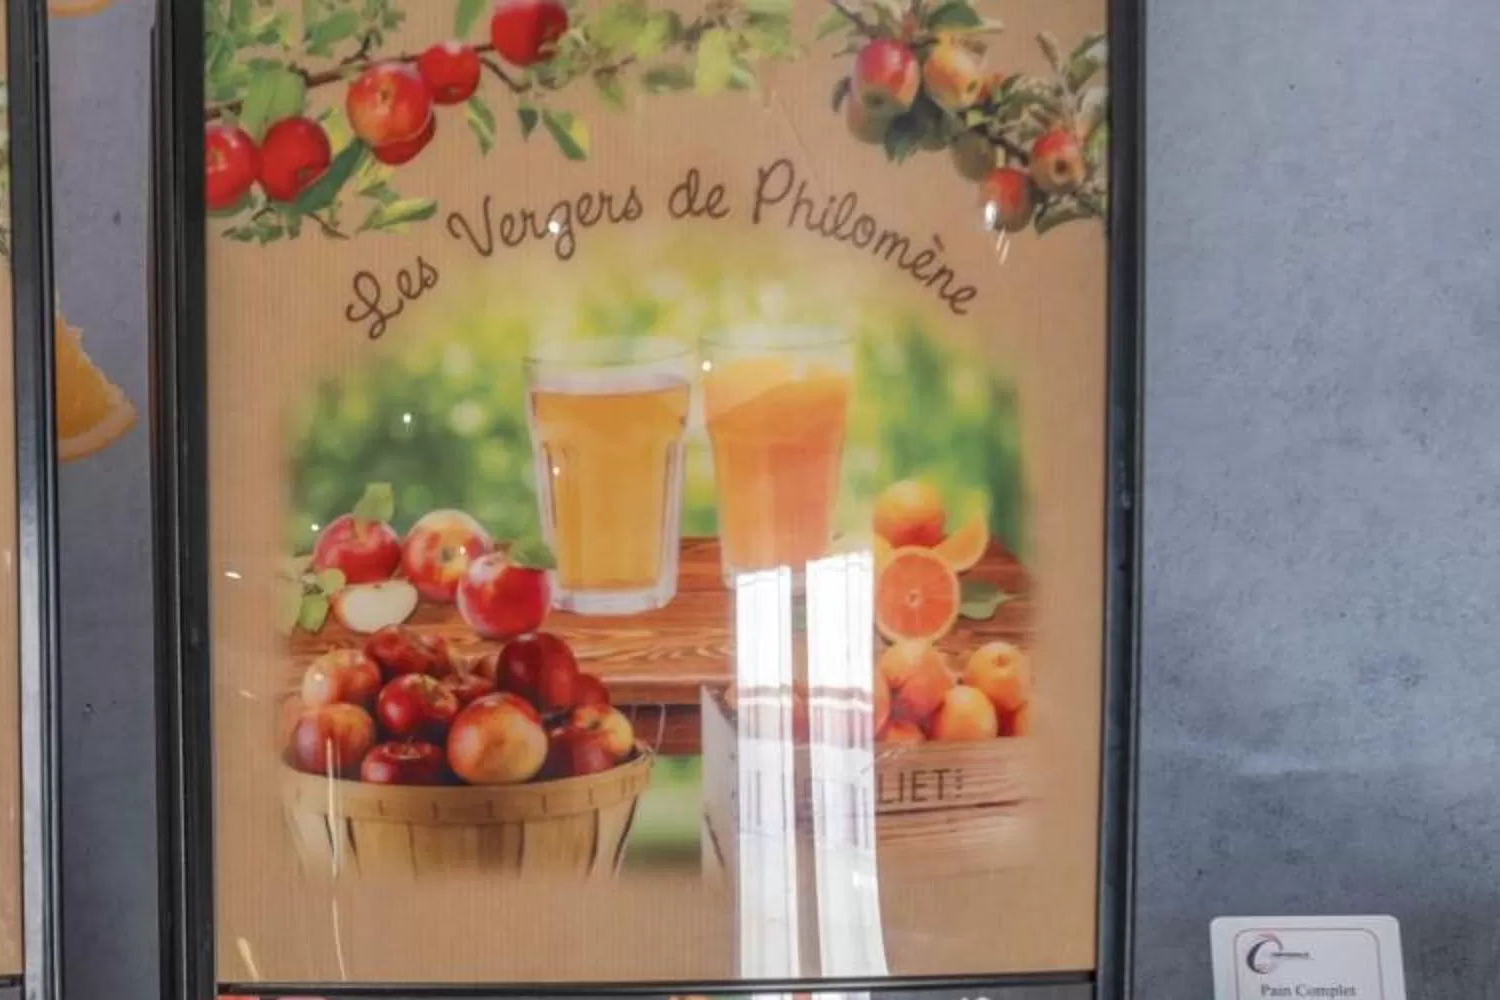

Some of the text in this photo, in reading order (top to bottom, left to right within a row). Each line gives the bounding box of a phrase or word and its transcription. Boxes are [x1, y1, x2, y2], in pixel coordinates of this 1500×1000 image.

[346, 158, 977, 339] Les Vergers de Philomène
[1261, 983, 1293, 998] Pain
